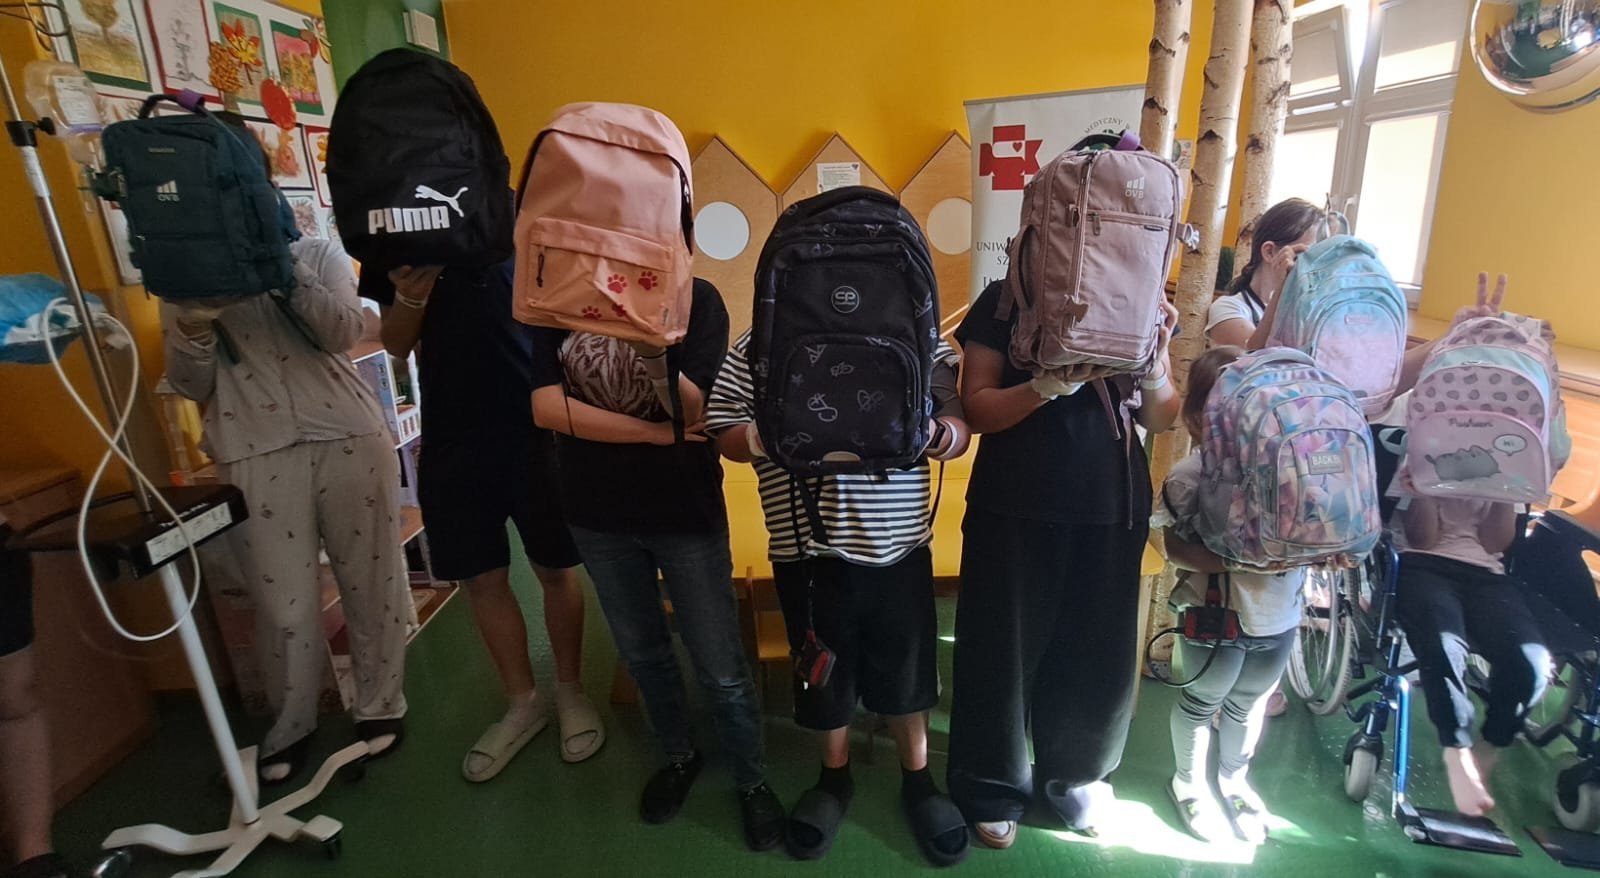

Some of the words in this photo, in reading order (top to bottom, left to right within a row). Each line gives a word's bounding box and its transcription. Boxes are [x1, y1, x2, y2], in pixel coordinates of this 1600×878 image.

[1084, 117, 1123, 133] MEDYCZNY
[1124, 189, 1144, 200] OVB
[368, 205, 450, 235] PUMA
[976, 241, 1007, 251] UNIW
[996, 255, 1009, 266] SZ
